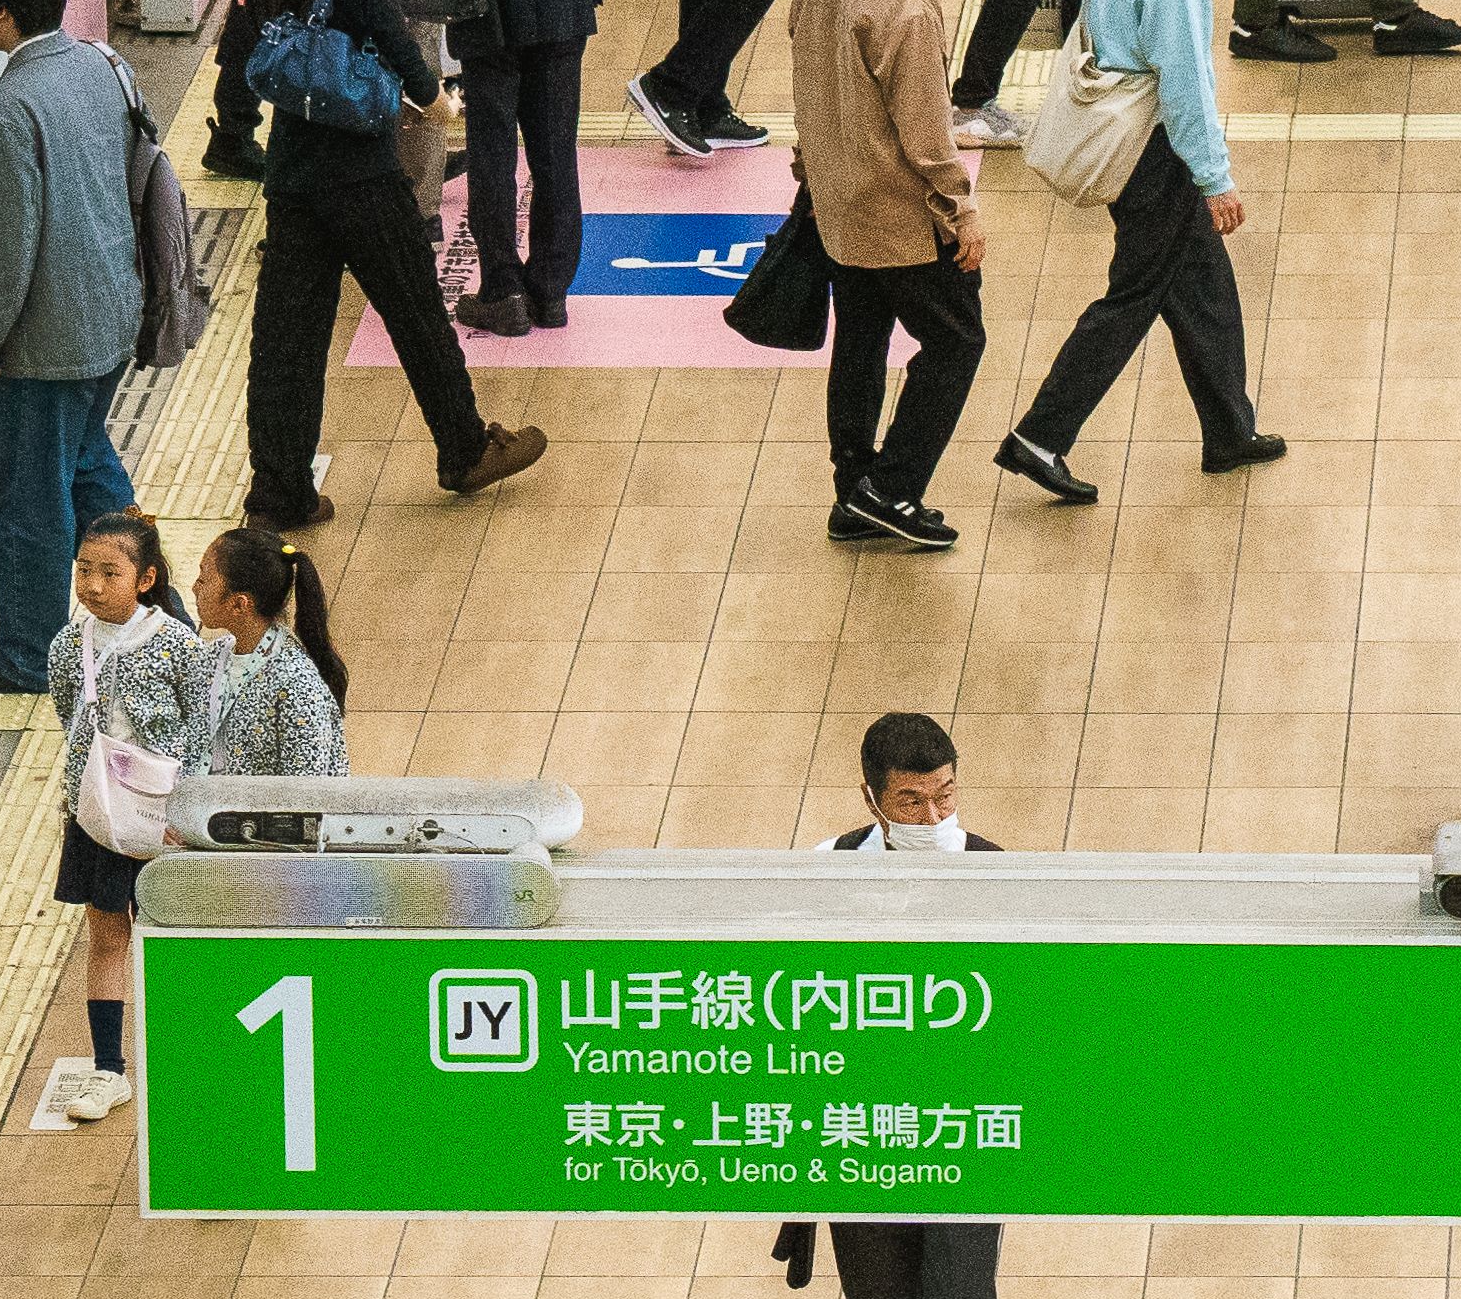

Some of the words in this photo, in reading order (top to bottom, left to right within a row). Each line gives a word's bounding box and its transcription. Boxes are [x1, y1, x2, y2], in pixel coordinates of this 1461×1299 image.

[455, 1001, 511, 1042] JY
[560, 968, 995, 1034] 山手線(内回り)
[236, 976, 316, 1171] 1
[562, 1042, 753, 1076] Yamanote
[767, 1043, 846, 1076] Line
[562, 1100, 1023, 1153] 東京・上野・巣鴨方面
[564, 1156, 604, 1184] for
[615, 1155, 709, 1191] Tōkyō,
[720, 1156, 798, 1184] Ueno
[808, 1156, 829, 1184] &
[838, 1156, 963, 1192] Sugamo
